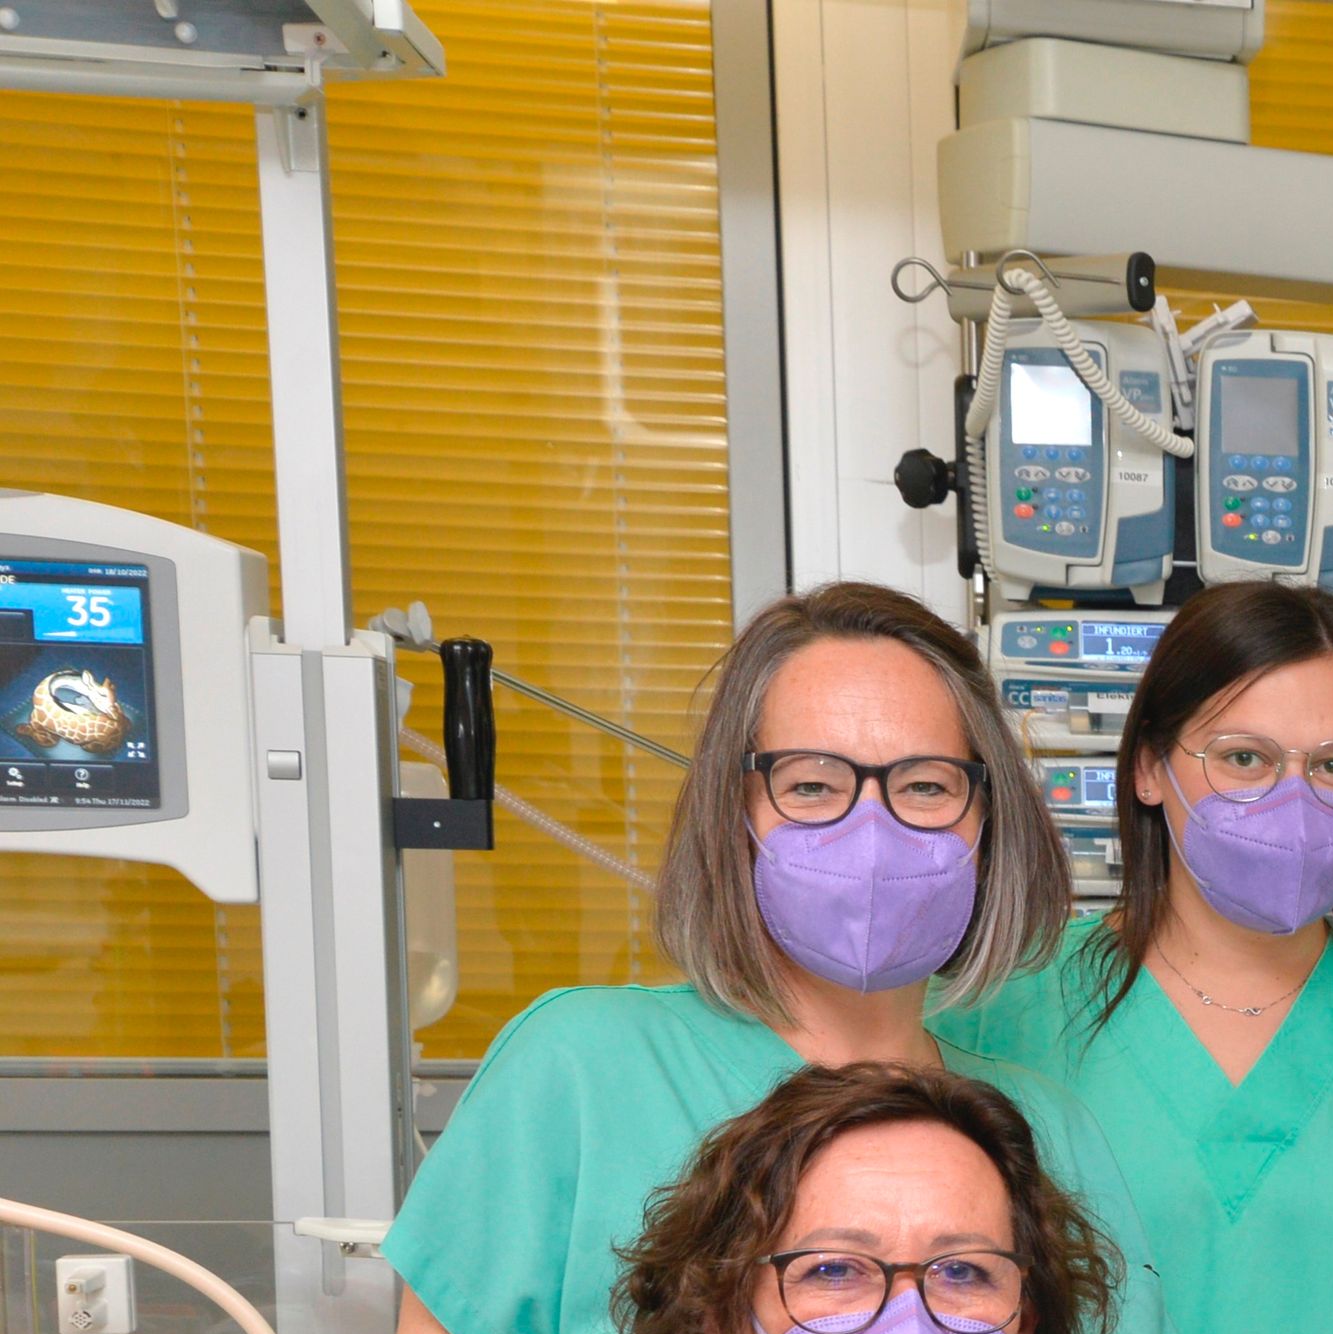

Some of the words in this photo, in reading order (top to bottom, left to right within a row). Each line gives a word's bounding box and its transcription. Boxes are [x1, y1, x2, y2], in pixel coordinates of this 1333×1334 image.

[1118, 471, 1149, 483] 10087
[66, 596, 112, 627] 35
[1094, 625, 1148, 637] INFUNDIERT
